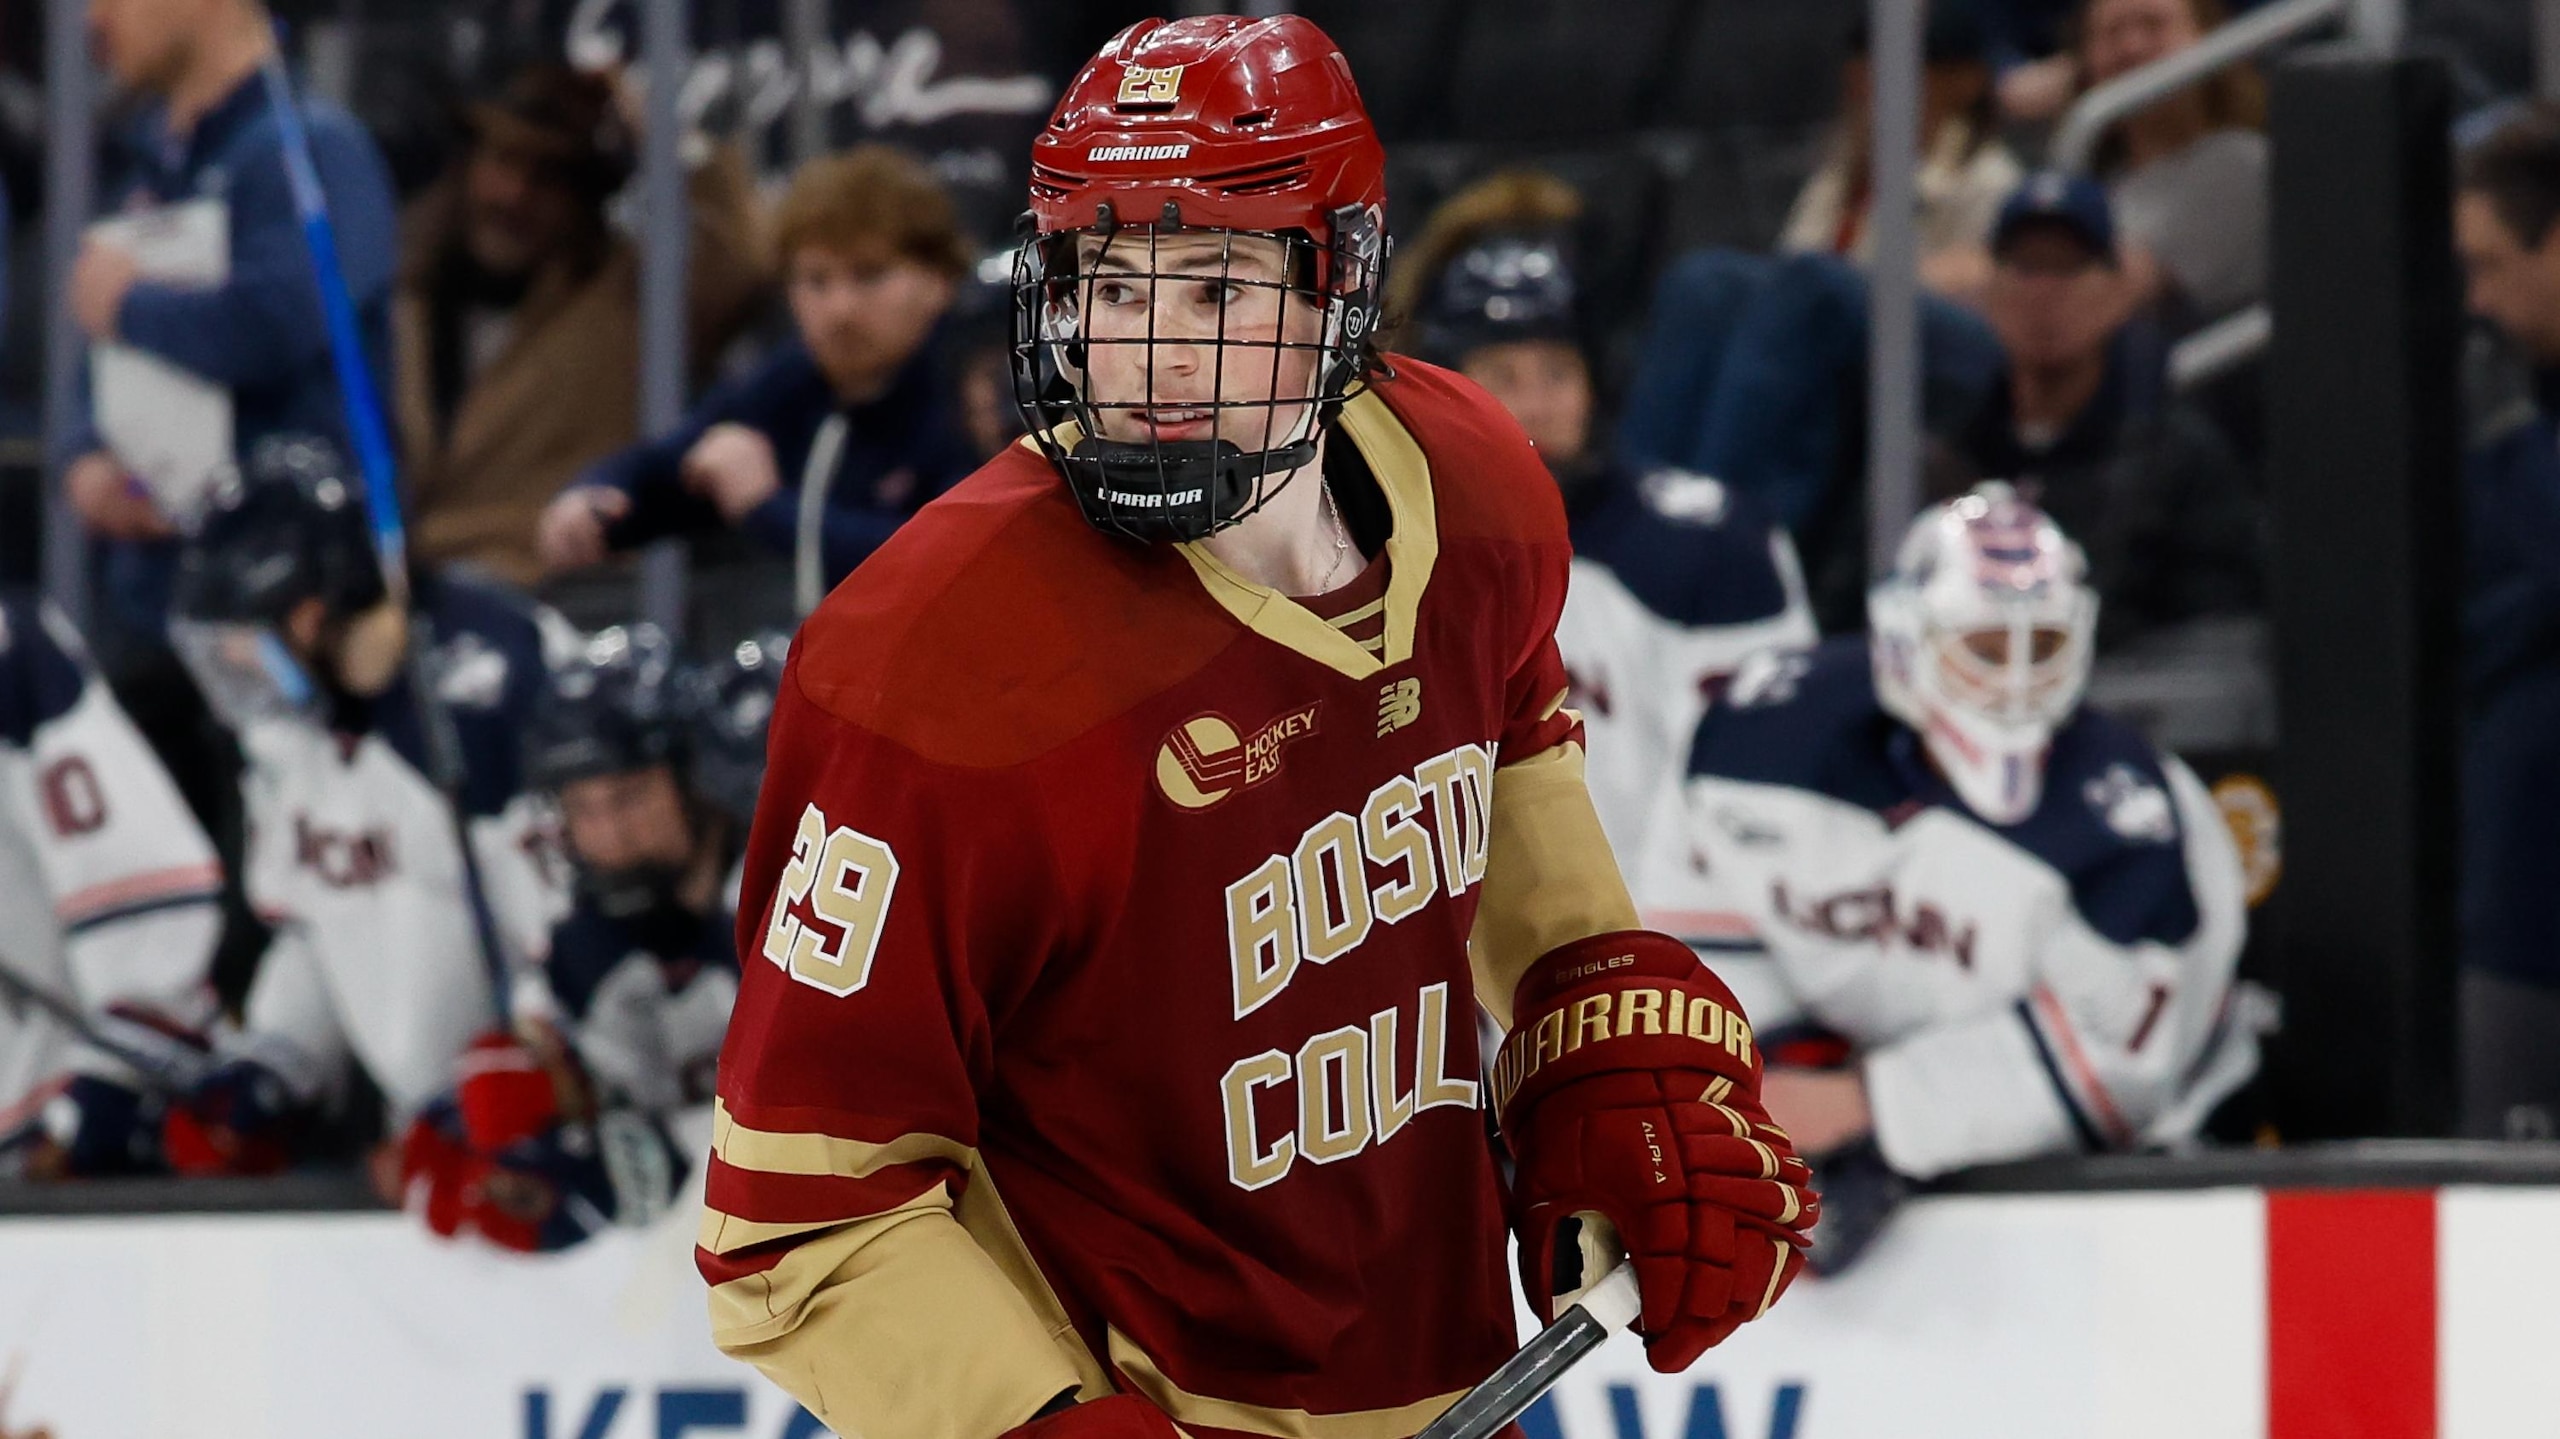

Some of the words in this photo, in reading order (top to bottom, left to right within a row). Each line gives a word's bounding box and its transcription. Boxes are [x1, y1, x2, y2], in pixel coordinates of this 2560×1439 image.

[1117, 64, 1184, 103] 29
[1088, 144, 1190, 162] WARRIOR
[1245, 708, 1315, 763] HOCKEY
[1245, 744, 1280, 784] EAST
[763, 802, 900, 998] 29
[1225, 740, 1499, 1022] BOSTO
[1219, 981, 1487, 1192] COLL
[1491, 988, 1753, 1127] WARRIOR
[1641, 1121, 1667, 1184] ALPHA
